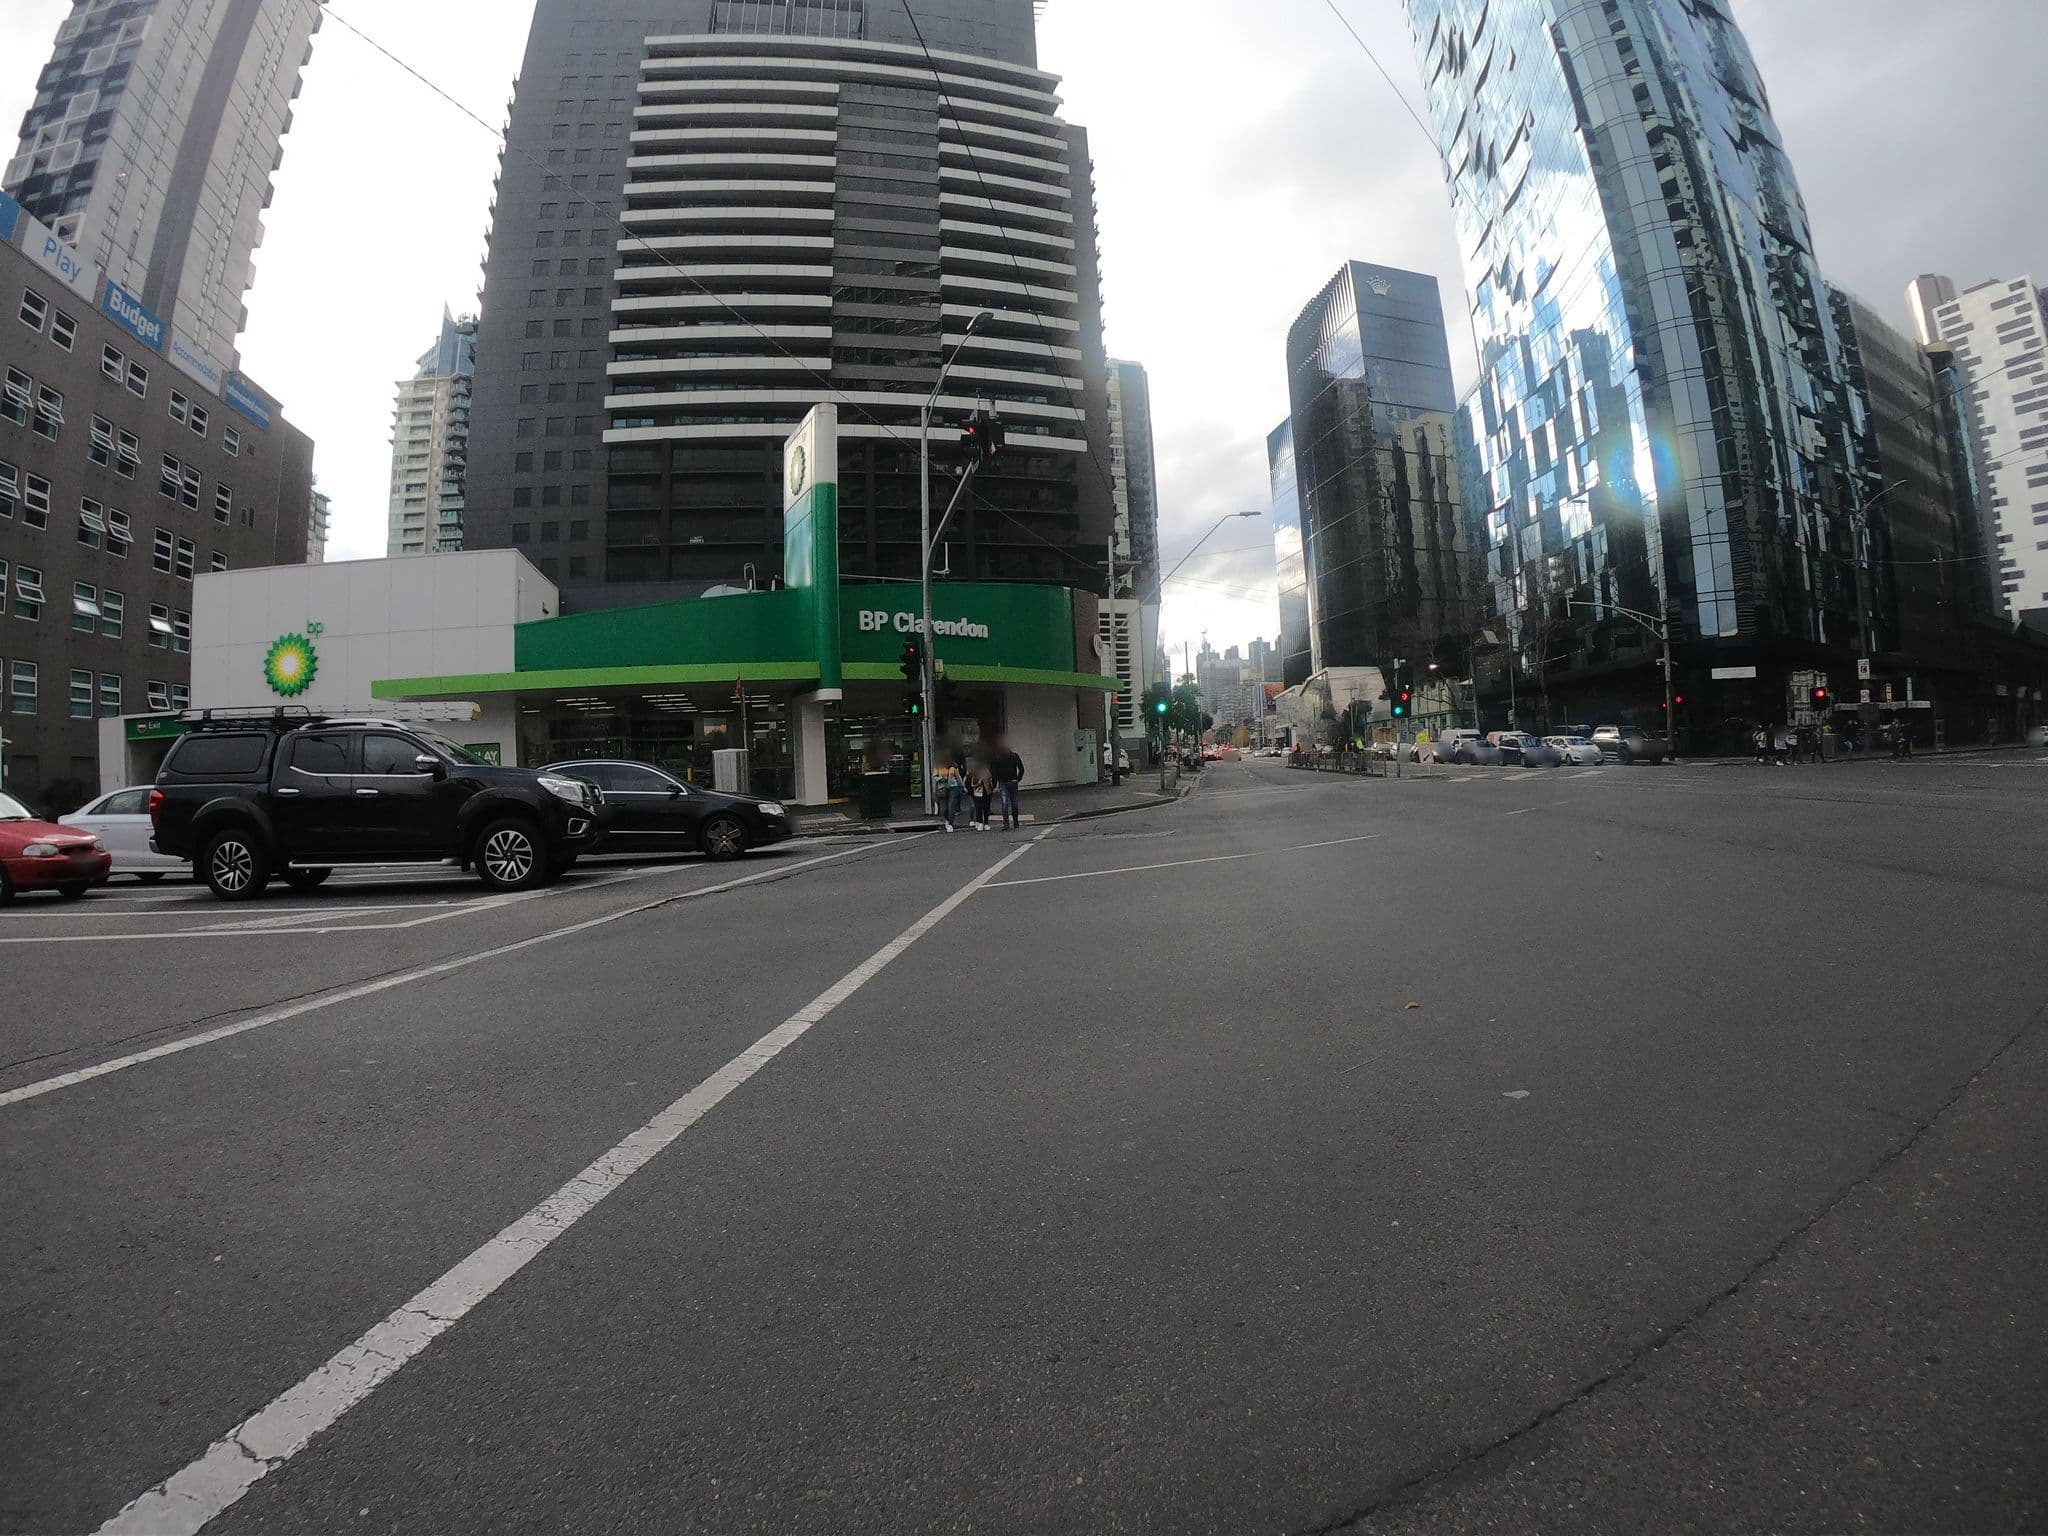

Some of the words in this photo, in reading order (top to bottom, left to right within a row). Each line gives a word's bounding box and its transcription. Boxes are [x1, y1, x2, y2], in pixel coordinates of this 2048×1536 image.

[43, 236, 80, 283] Play
[110, 288, 160, 341] Budget
[306, 619, 324, 637] bp
[859, 610, 889, 631] BP
